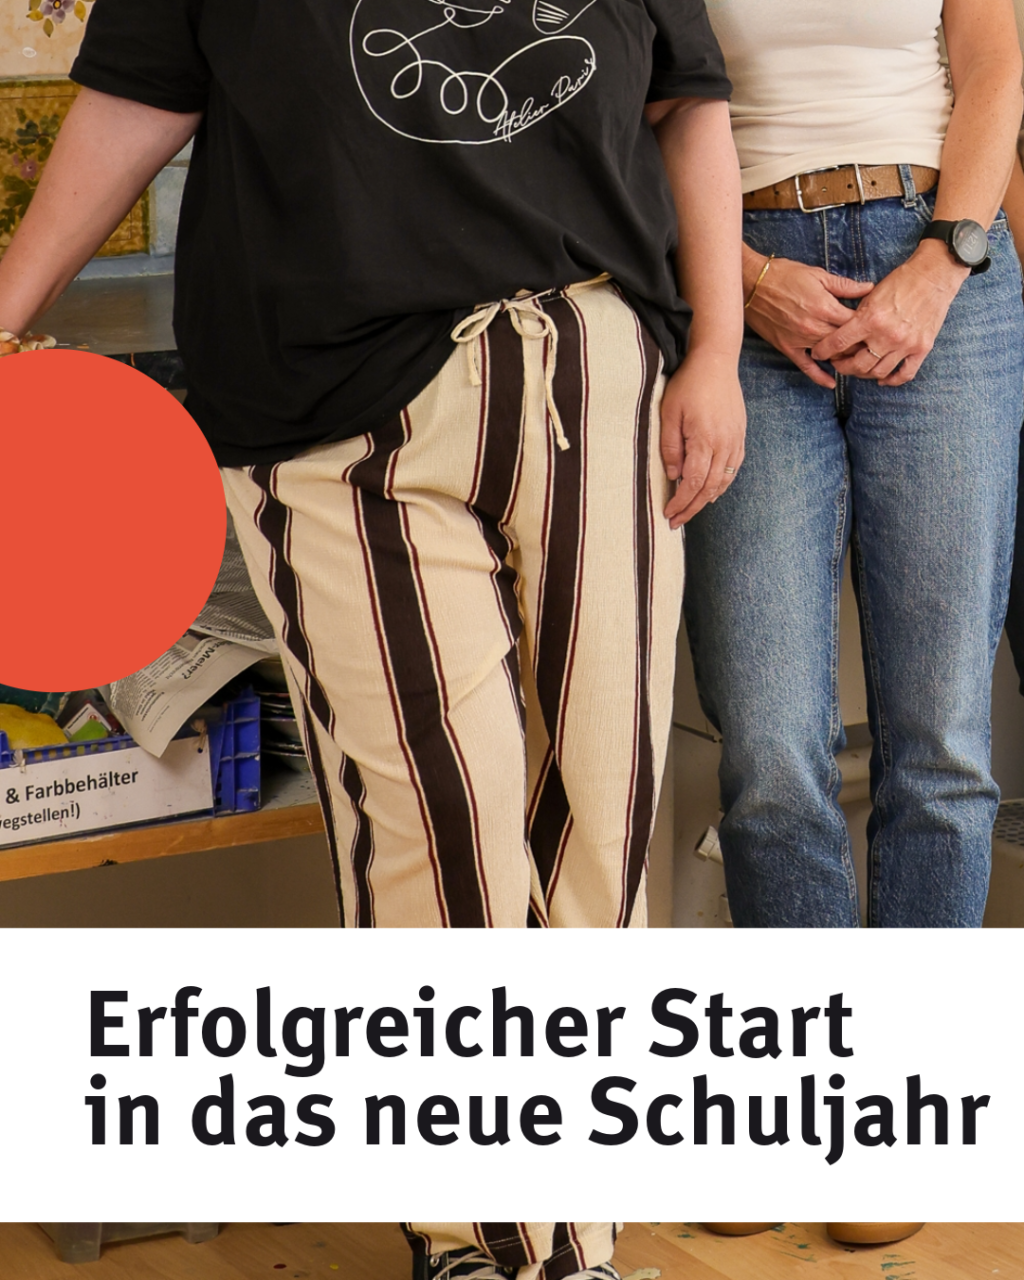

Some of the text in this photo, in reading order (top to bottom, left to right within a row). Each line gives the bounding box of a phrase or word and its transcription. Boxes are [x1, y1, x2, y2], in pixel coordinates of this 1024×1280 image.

[493, 58, 597, 143] Atelier Paris
[5, 770, 139, 805] & Farbbehälter
